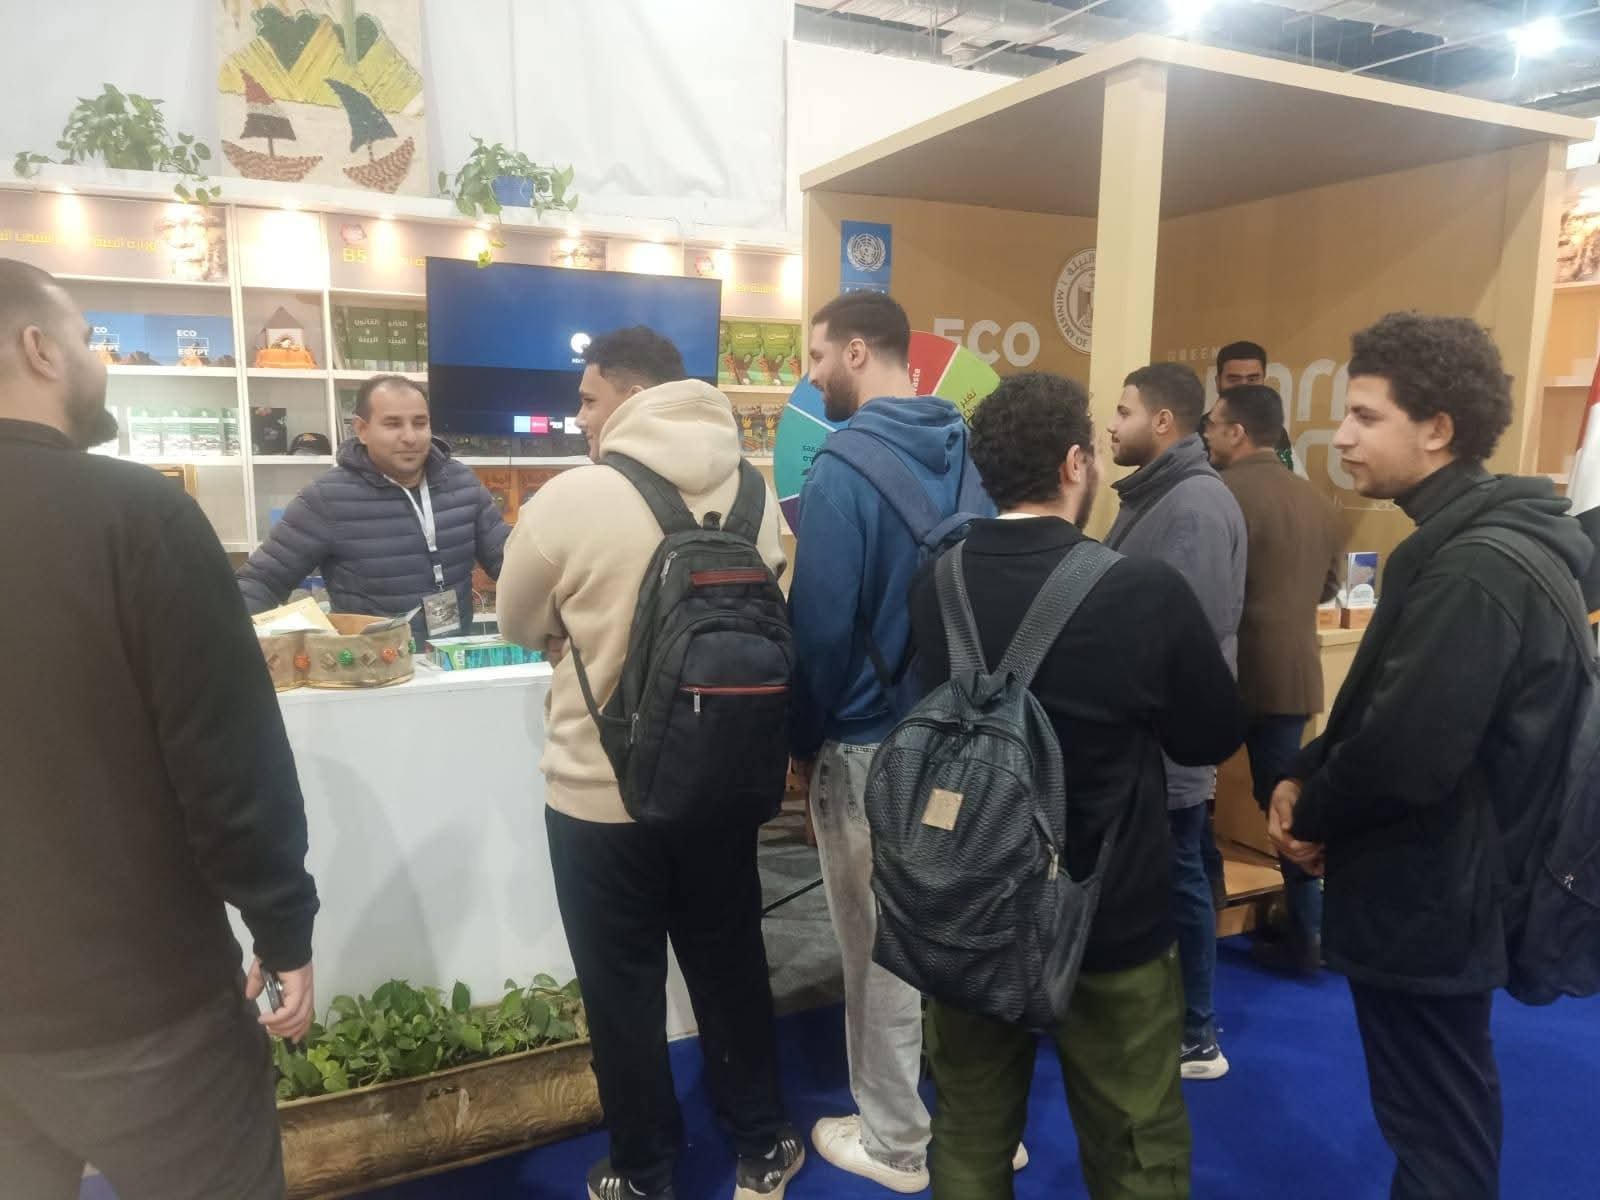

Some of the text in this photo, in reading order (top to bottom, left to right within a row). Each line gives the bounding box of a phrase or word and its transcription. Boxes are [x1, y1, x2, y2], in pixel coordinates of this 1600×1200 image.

[1056, 289, 1076, 339] MINISTRY
[176, 329, 198, 337] ECO
[933, 318, 1040, 367] ECO
[178, 348, 209, 356] EGYPT
